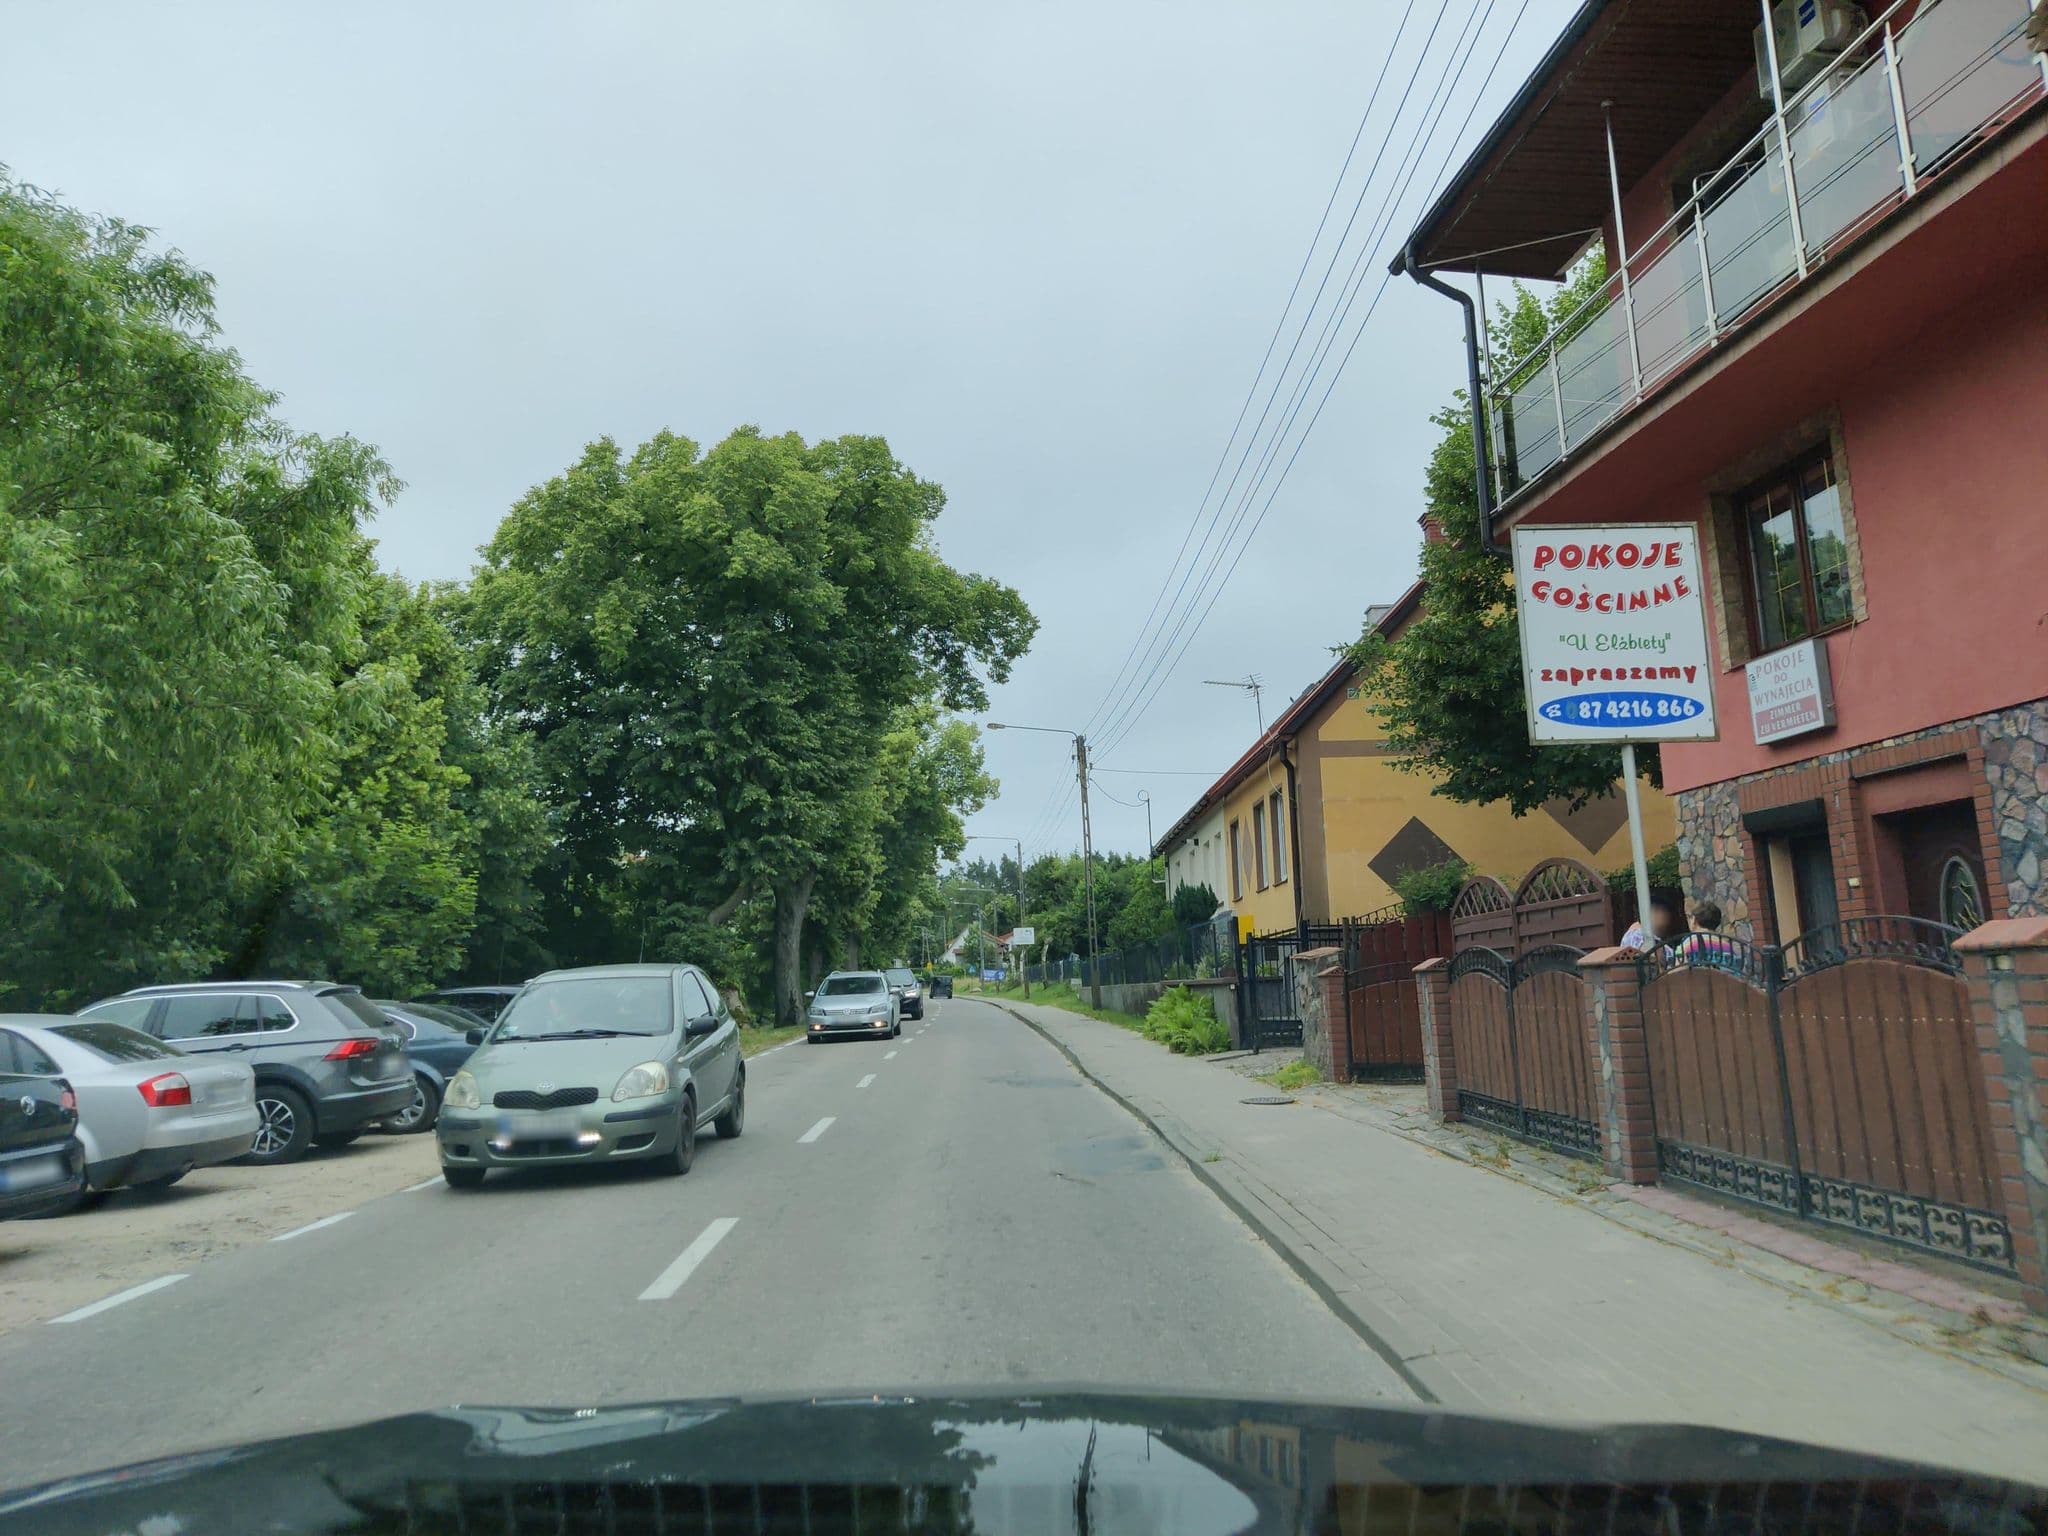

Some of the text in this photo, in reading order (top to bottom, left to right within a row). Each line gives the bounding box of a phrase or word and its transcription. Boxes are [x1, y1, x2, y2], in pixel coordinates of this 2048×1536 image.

[1533, 541, 1682, 571] POKOJE
[1532, 575, 1691, 613] GOŚCINNE
[1541, 665, 1697, 687] zapraszamy
[1755, 649, 1805, 678] POKOJE
[1774, 672, 1788, 684] DO
[1606, 700, 1652, 719] 4216
[1657, 699, 1695, 717] 866
